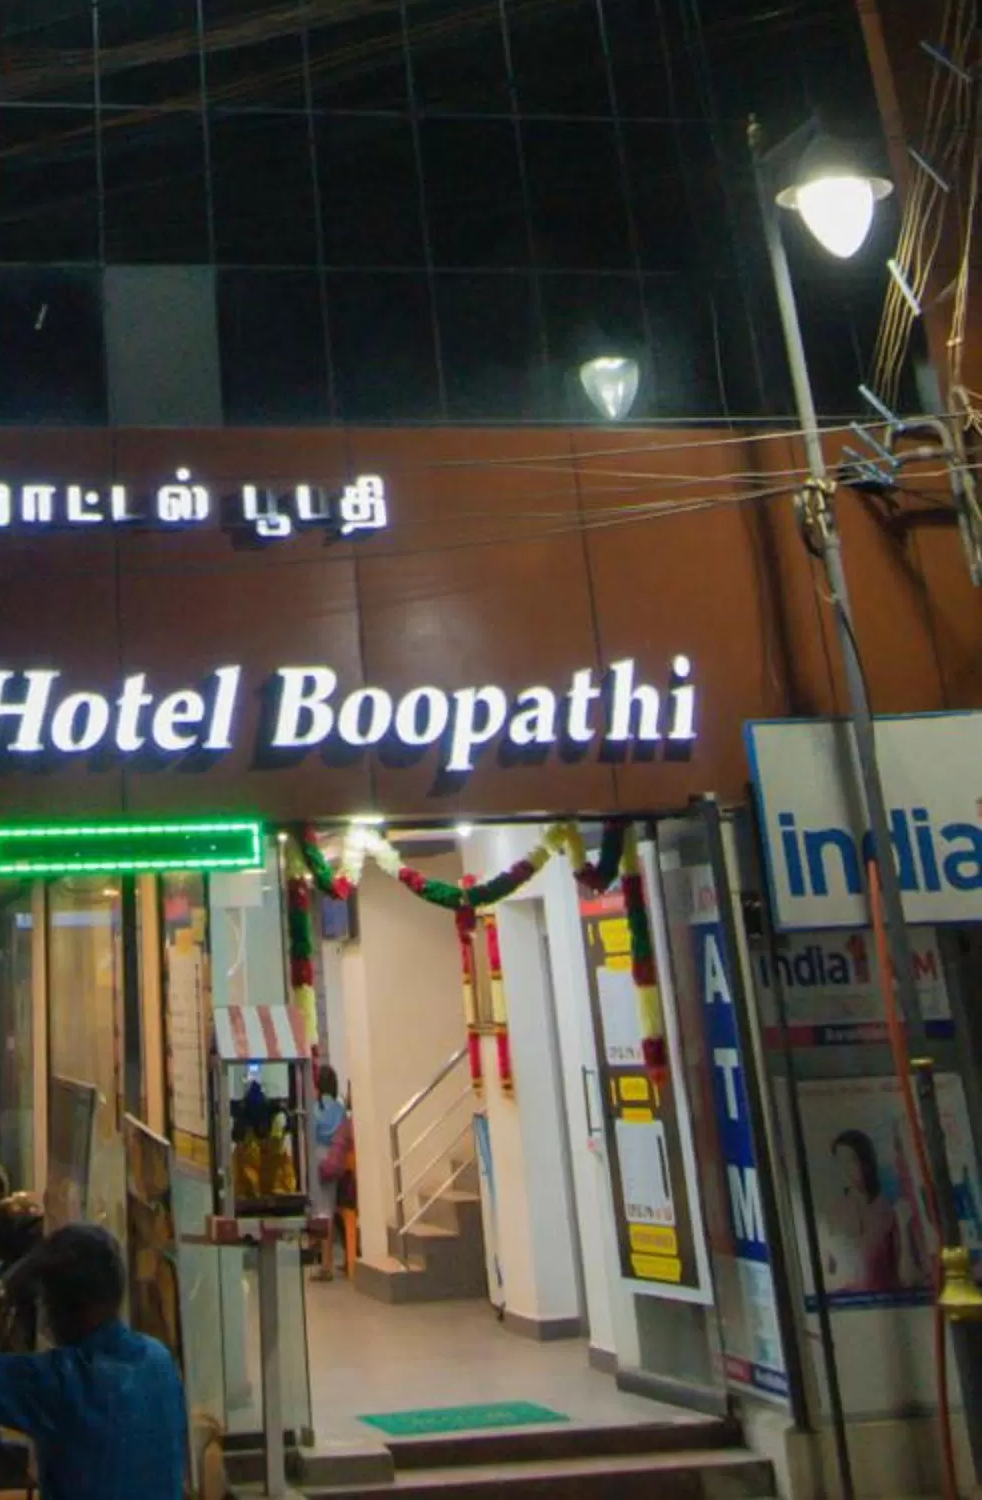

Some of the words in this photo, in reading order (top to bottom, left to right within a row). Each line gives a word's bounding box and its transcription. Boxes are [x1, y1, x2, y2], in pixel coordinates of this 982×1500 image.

[242, 473, 387, 536] பூபதி
[270, 654, 698, 772] Boopathi
[704, 933, 766, 1242] ATM
